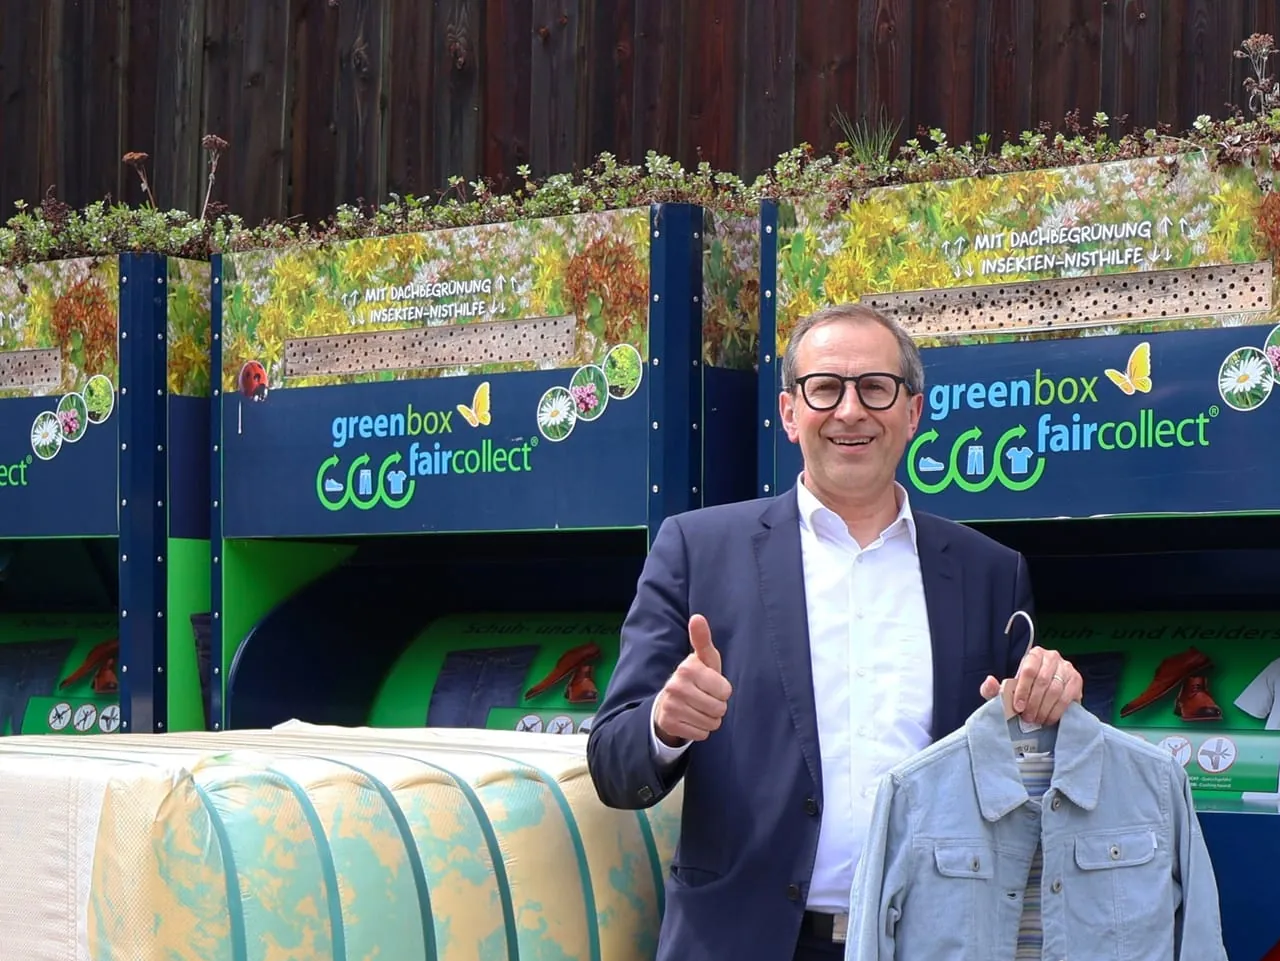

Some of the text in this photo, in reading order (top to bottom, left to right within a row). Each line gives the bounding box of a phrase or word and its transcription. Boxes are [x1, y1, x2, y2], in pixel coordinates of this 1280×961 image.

[974, 221, 1151, 251] MIT DACHBEGRÜNUNG
[981, 247, 1144, 275] INSEKTEN-NISTHILFE
[365, 287, 386, 303] MIT
[370, 301, 486, 324] INSEKTEN-NISTHILFE
[929, 368, 1098, 421] greenbox
[332, 403, 453, 448] greenbox
